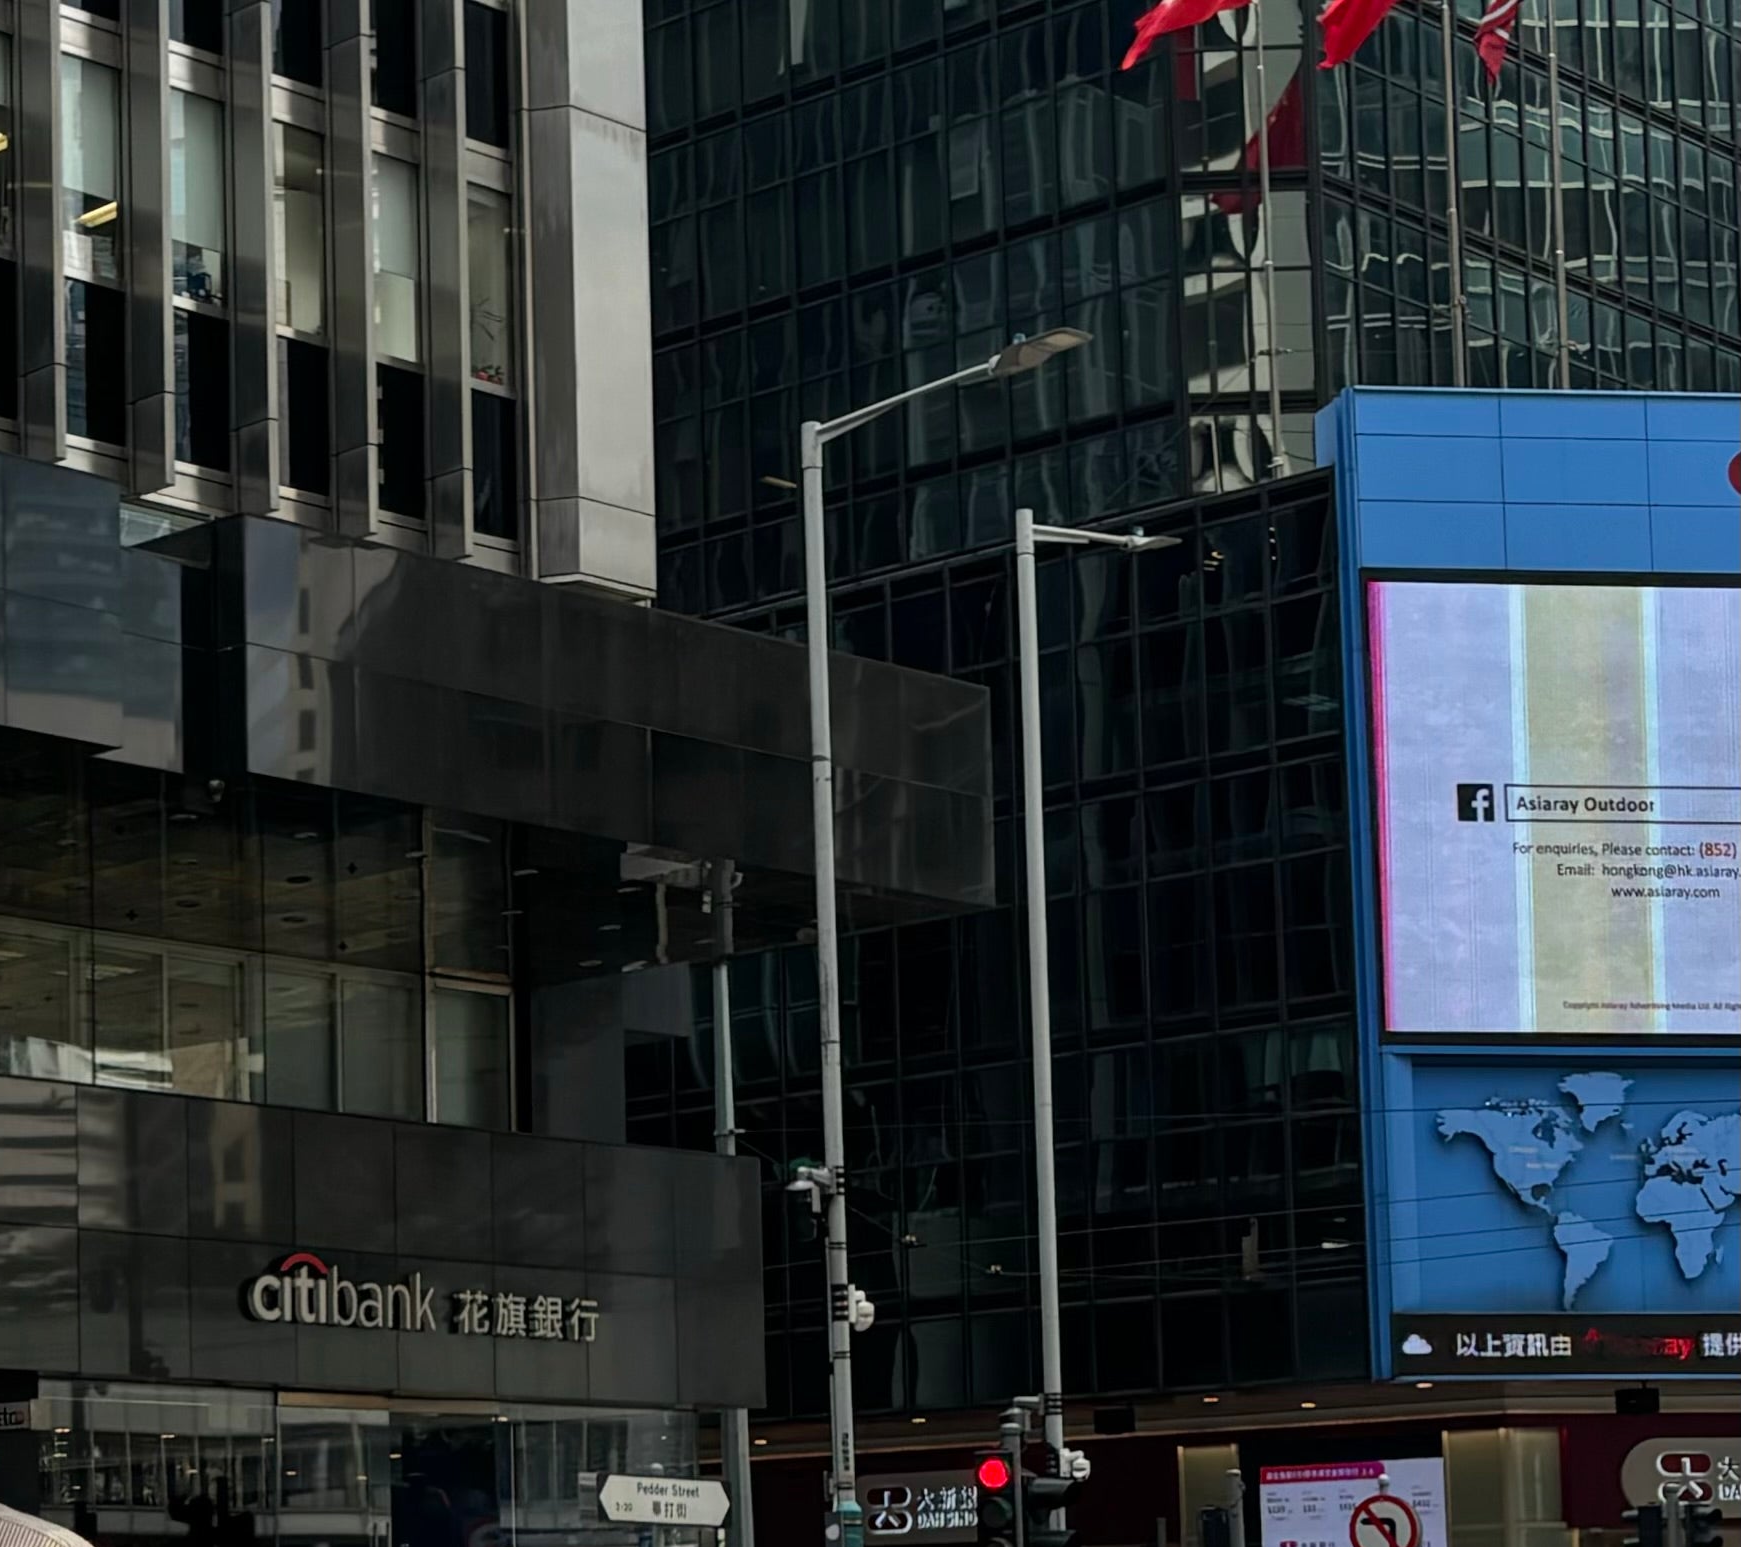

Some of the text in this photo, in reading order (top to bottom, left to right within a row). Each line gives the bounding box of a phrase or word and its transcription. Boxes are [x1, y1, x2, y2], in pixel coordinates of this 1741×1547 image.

[1517, 796, 1655, 814] Asiaray Outdoor
[1513, 842, 1737, 859] For enquiries, Please contact: (852)
[1557, 863, 1595, 876] Email:
[1611, 886, 1721, 899] www.asiaray.com
[252, 1253, 601, 1342] citibank 花旗銀行
[1456, 1333, 1572, 1357] 以上資訊由
[637, 1482, 700, 1498] Pedder Street
